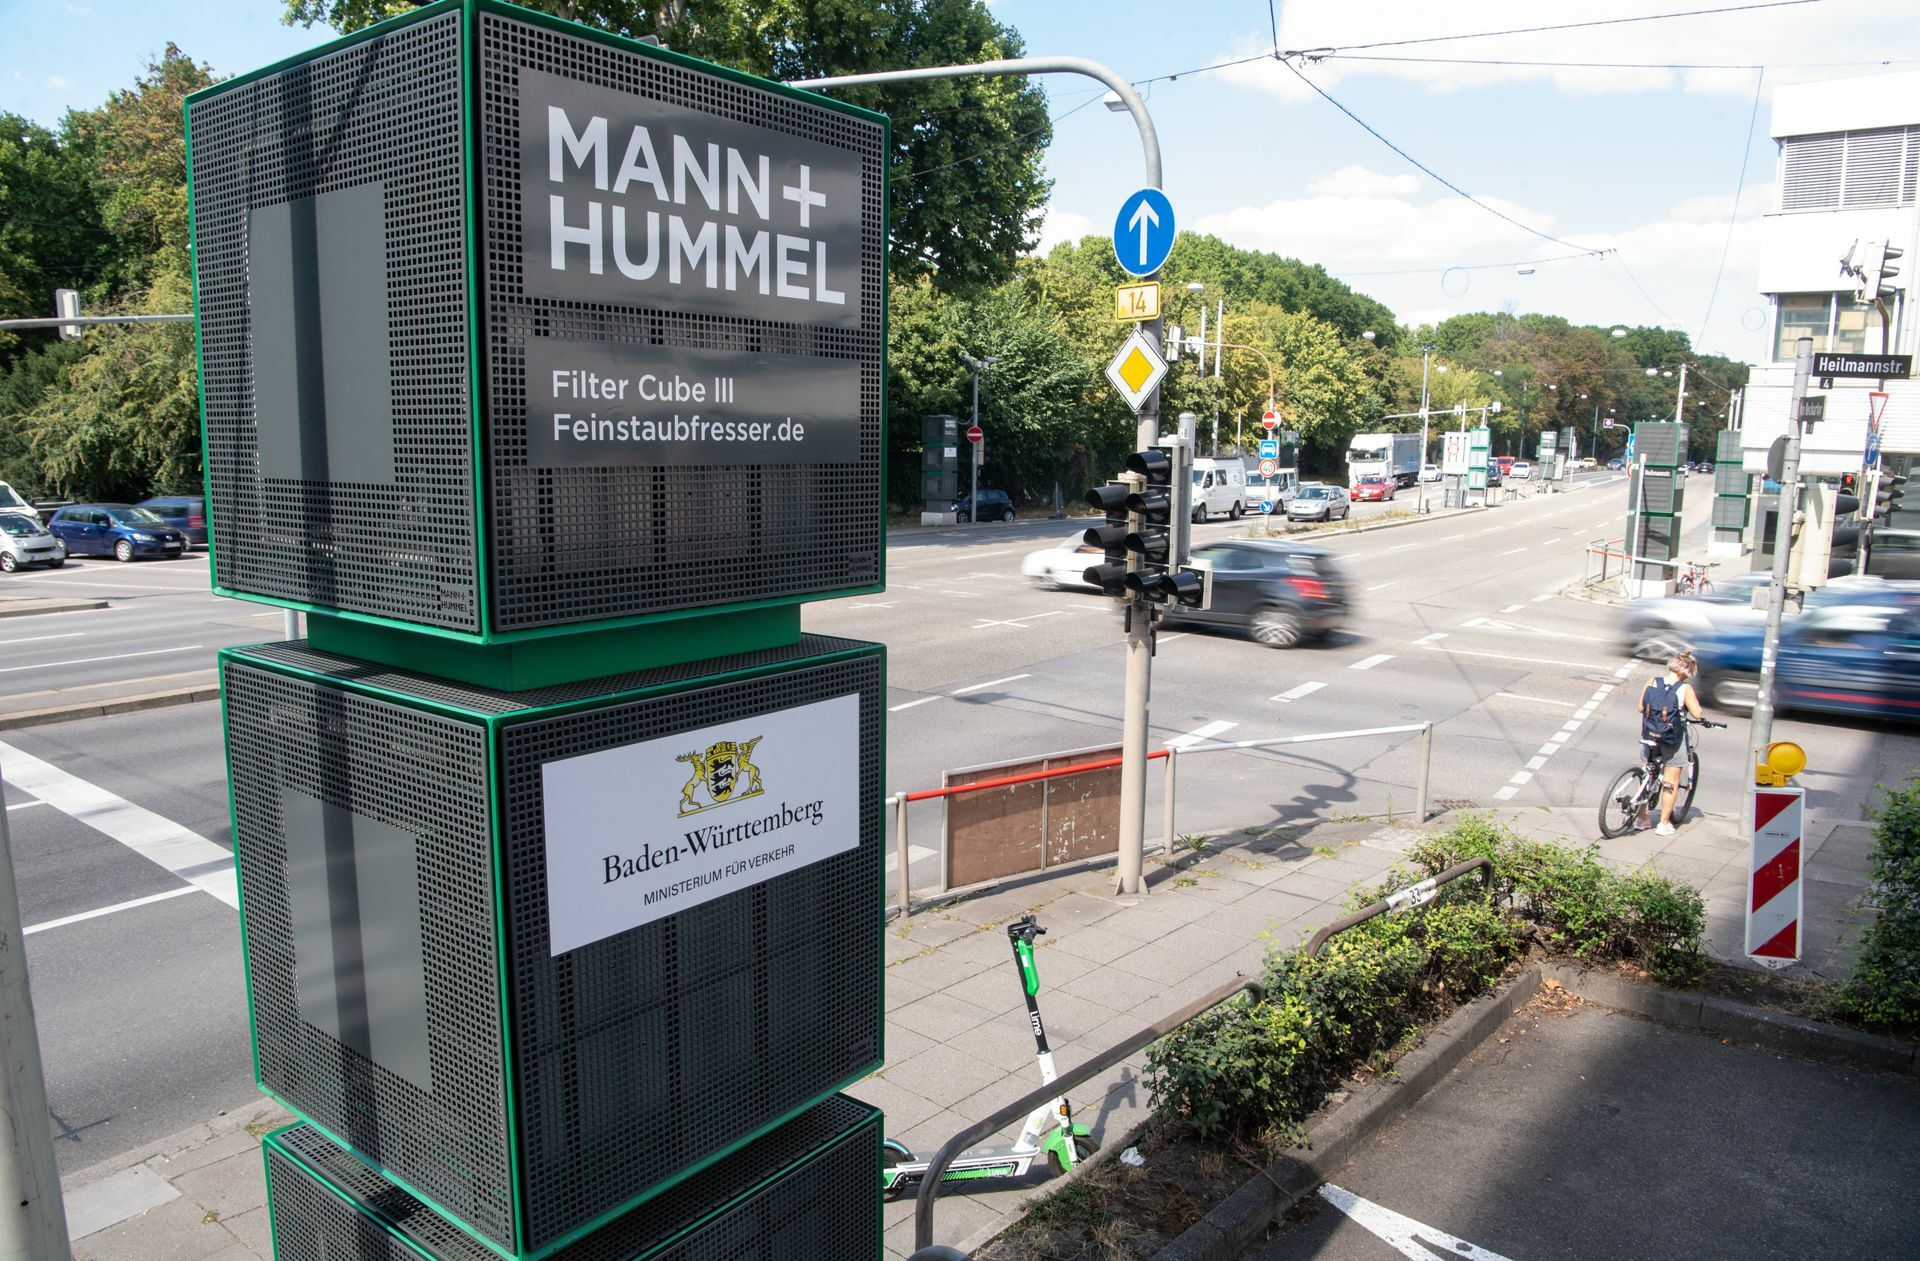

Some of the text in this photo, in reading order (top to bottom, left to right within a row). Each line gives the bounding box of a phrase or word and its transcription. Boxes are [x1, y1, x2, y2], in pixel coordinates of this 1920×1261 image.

[549, 194, 846, 305] HUMMEL
[1129, 290, 1146, 313] 14
[1818, 356, 1905, 374] Heilmannstr.
[552, 370, 734, 403] Filter Cube III
[1823, 378, 1830, 389] 4
[553, 413, 805, 442] Feinstaubfresser.de
[1263, 463, 1273, 473] 40
[440, 600, 468, 612] HUMMEL
[602, 800, 824, 885] Baden-Württemberg
[644, 844, 795, 906] MINISTERIUM FÜR VERKEHR
[1030, 1010, 1042, 1036] Lime
